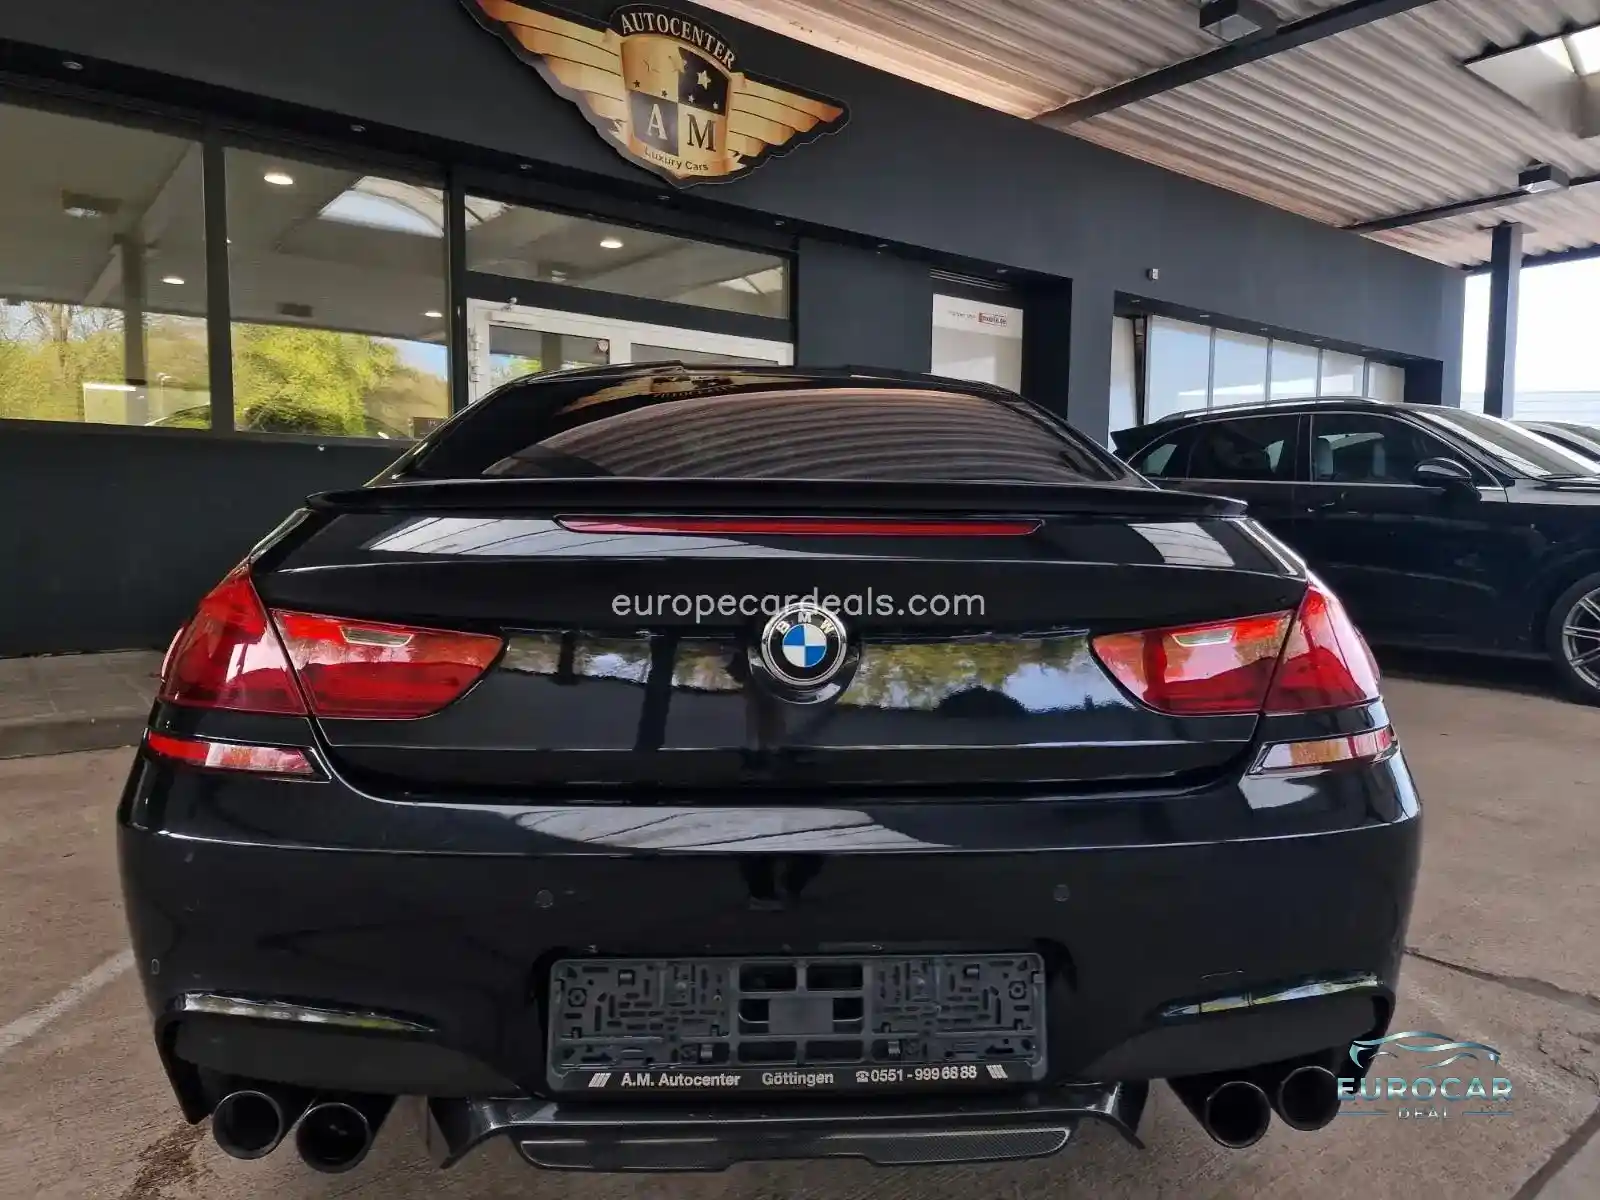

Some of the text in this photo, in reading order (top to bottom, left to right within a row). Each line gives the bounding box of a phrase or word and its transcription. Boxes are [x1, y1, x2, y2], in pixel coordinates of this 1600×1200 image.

[621, 12, 735, 71] AUTOCENTER
[646, 103, 717, 152] A M
[644, 145, 709, 171] Luxury Cars
[776, 611, 835, 635] BMW
[621, 1072, 655, 1087] A.M.
[658, 1072, 740, 1087] Autocenter
[762, 1071, 834, 1087] Göttingen
